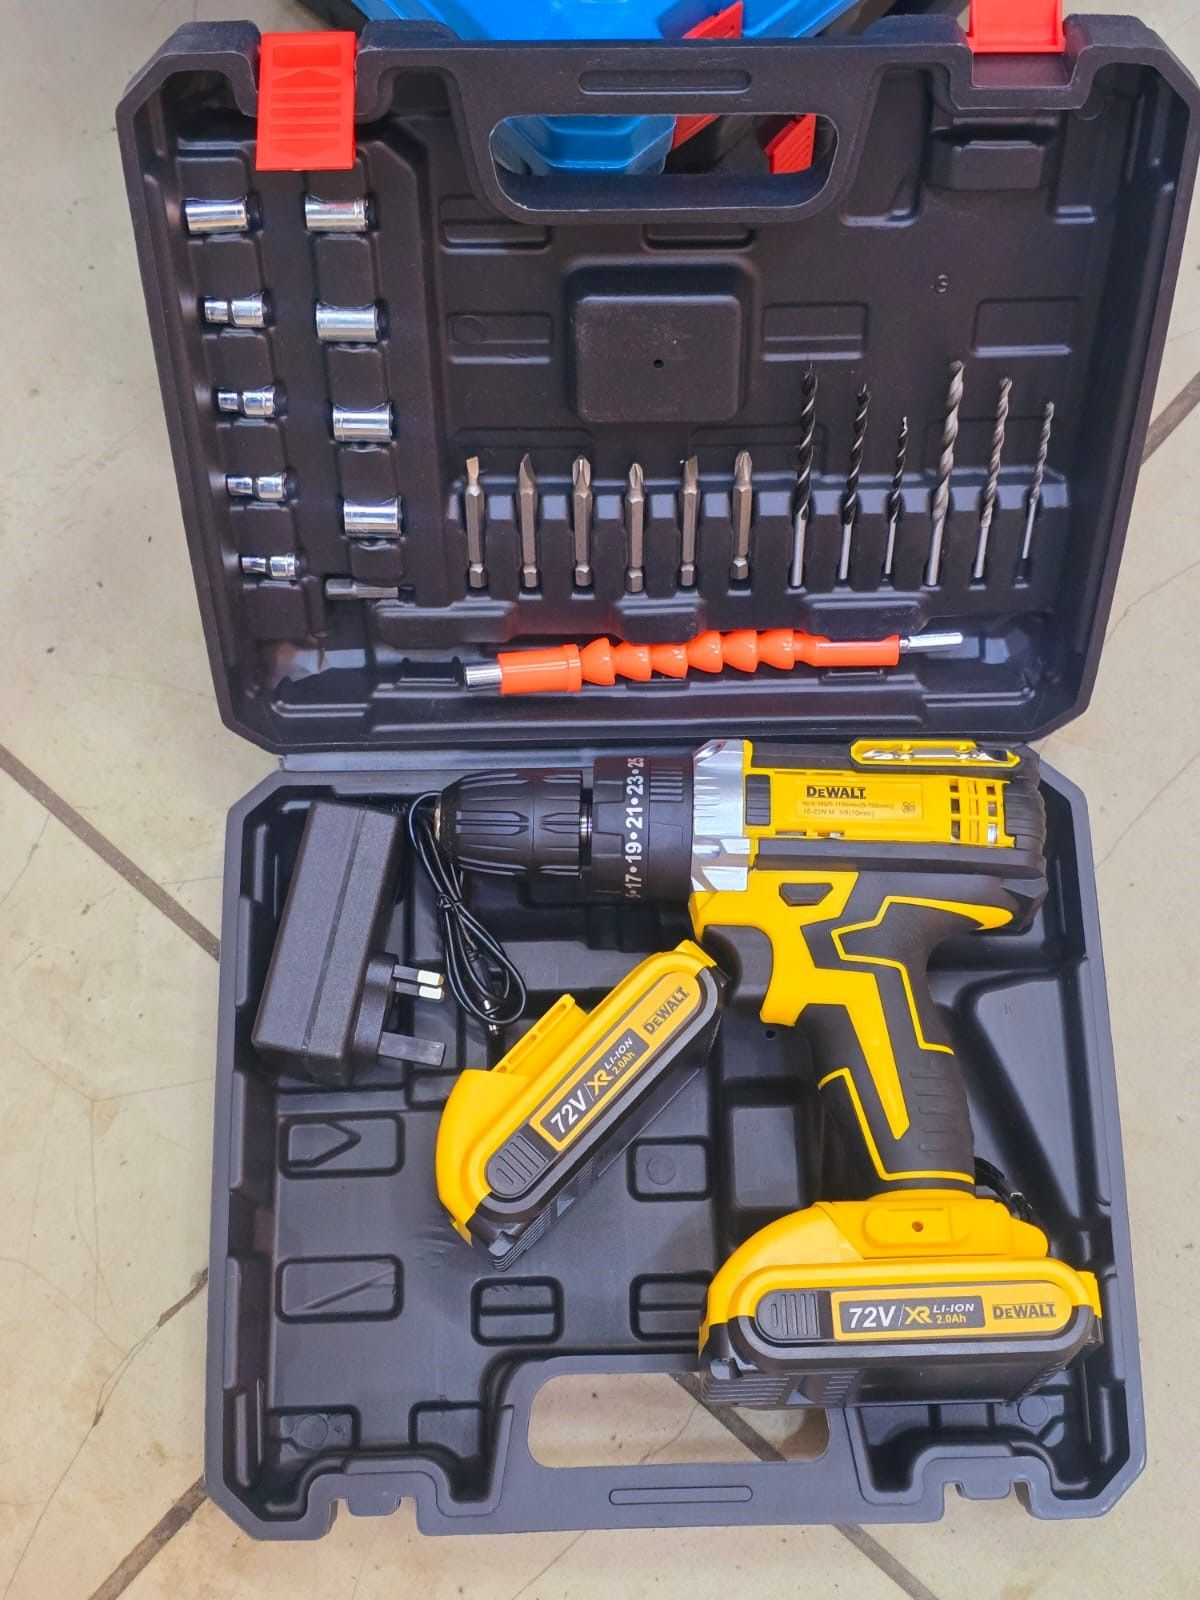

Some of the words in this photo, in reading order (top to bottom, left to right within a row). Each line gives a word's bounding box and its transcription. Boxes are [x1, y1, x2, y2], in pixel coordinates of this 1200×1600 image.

[627, 757, 644, 768] 25
[626, 775, 644, 795] 23
[625, 807, 643, 829] 21
[625, 841, 642, 863] 19
[625, 873, 642, 889] 17
[604, 1036, 633, 1070] LI-ION
[611, 1051, 636, 1075] 2.0Ah
[550, 1089, 587, 1134] 72V
[586, 1069, 614, 1096] XR
[849, 1305, 896, 1328] 72V
[904, 1306, 933, 1325] XR
[933, 1303, 974, 1313] LI-ION
[936, 1313, 967, 1324] 2.0Ah
